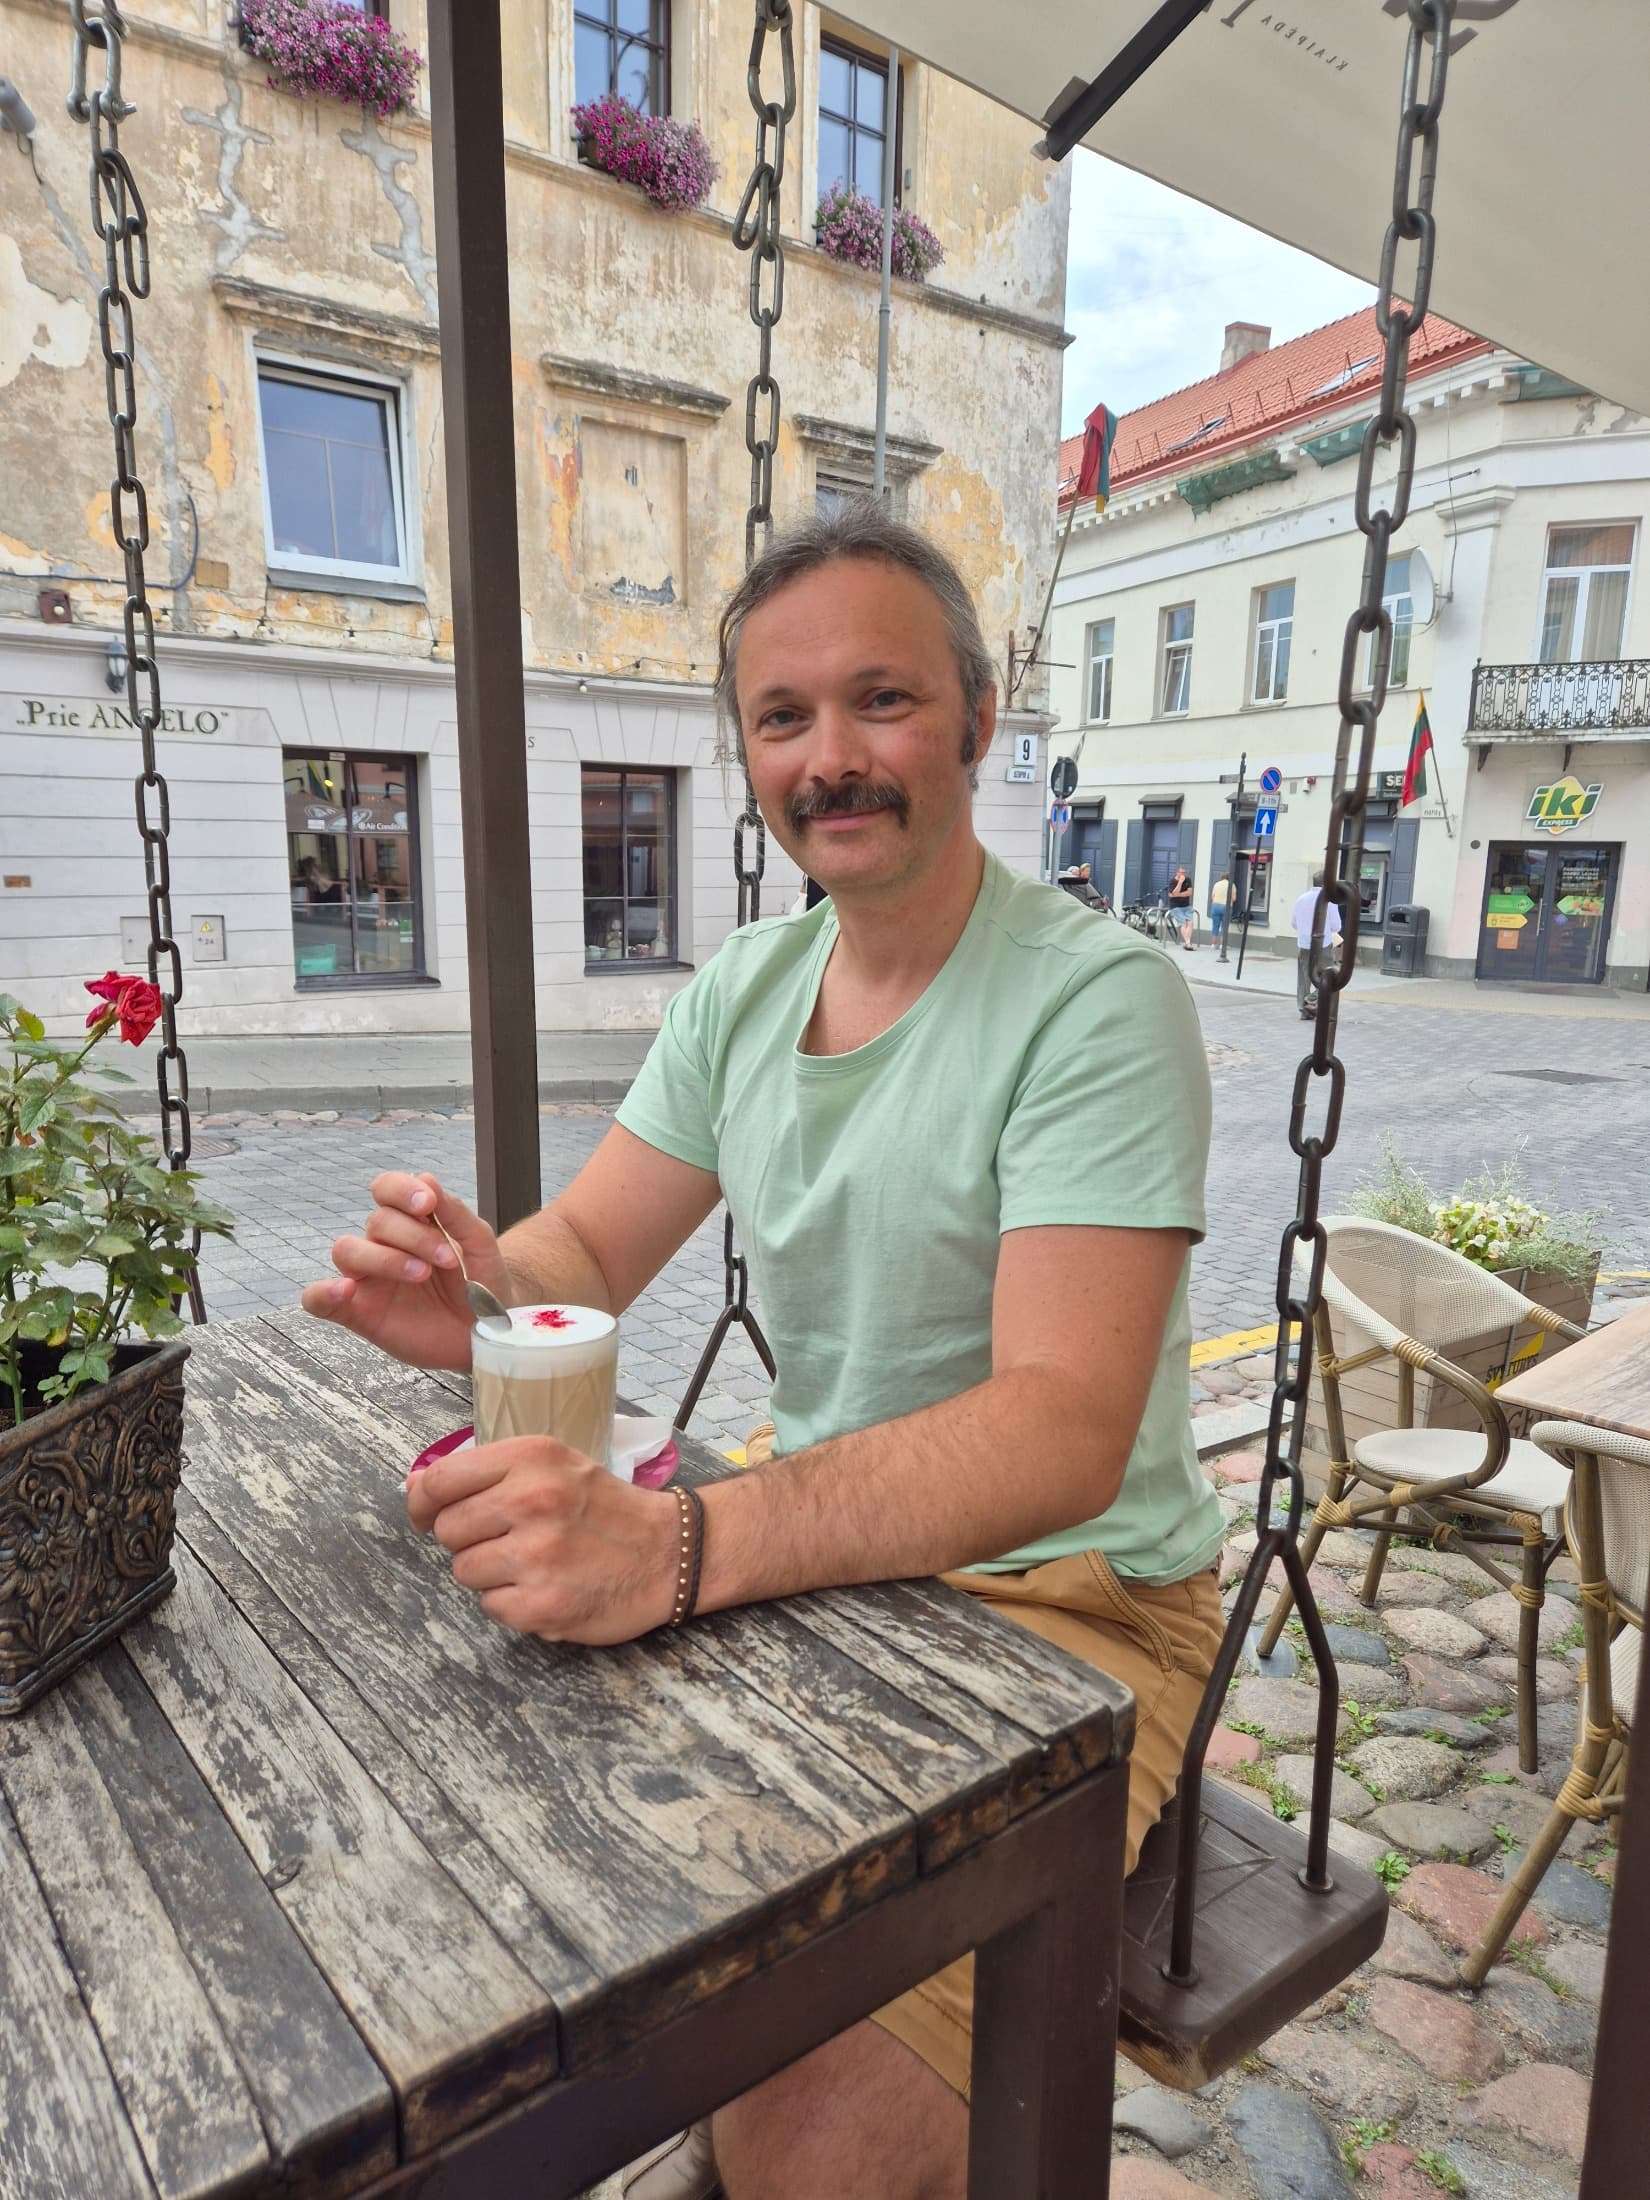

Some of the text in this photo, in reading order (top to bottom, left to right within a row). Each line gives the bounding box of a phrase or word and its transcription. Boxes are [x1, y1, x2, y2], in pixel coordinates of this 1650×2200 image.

[1022, 739, 1031, 761] 9
[1386, 774, 1405, 787] SE
[1529, 785, 1602, 816] iki
